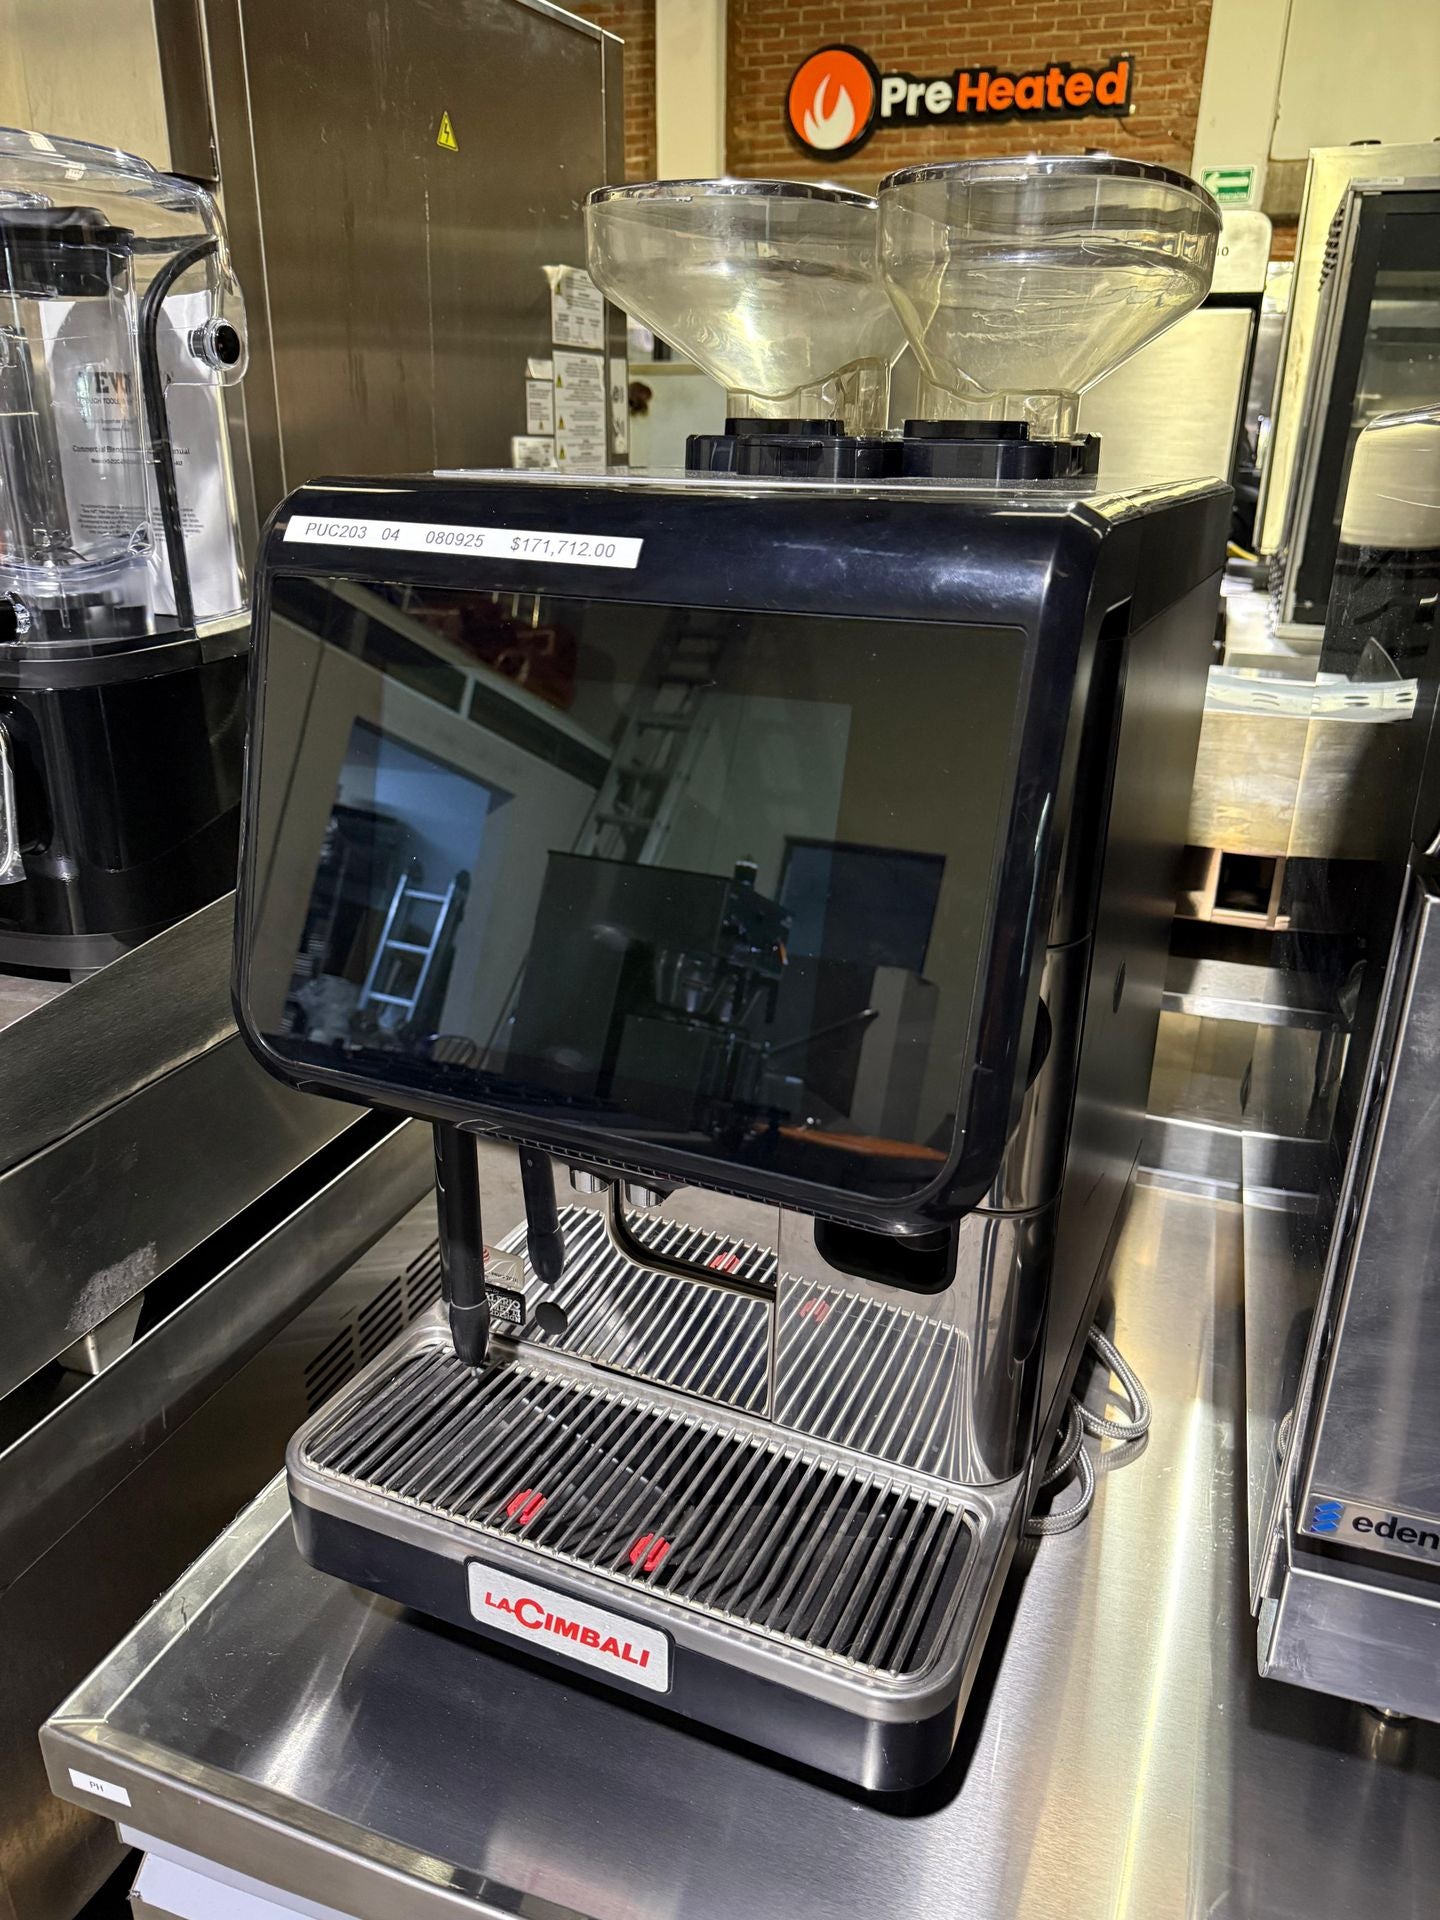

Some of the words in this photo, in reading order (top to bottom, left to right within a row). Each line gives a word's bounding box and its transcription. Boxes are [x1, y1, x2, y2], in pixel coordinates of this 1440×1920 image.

[305, 522, 368, 540] PUC203
[381, 527, 401, 541] 04
[425, 530, 486, 548] 080925
[510, 536, 616, 558] $171,712.00
[1351, 1516, 1440, 1550] eden
